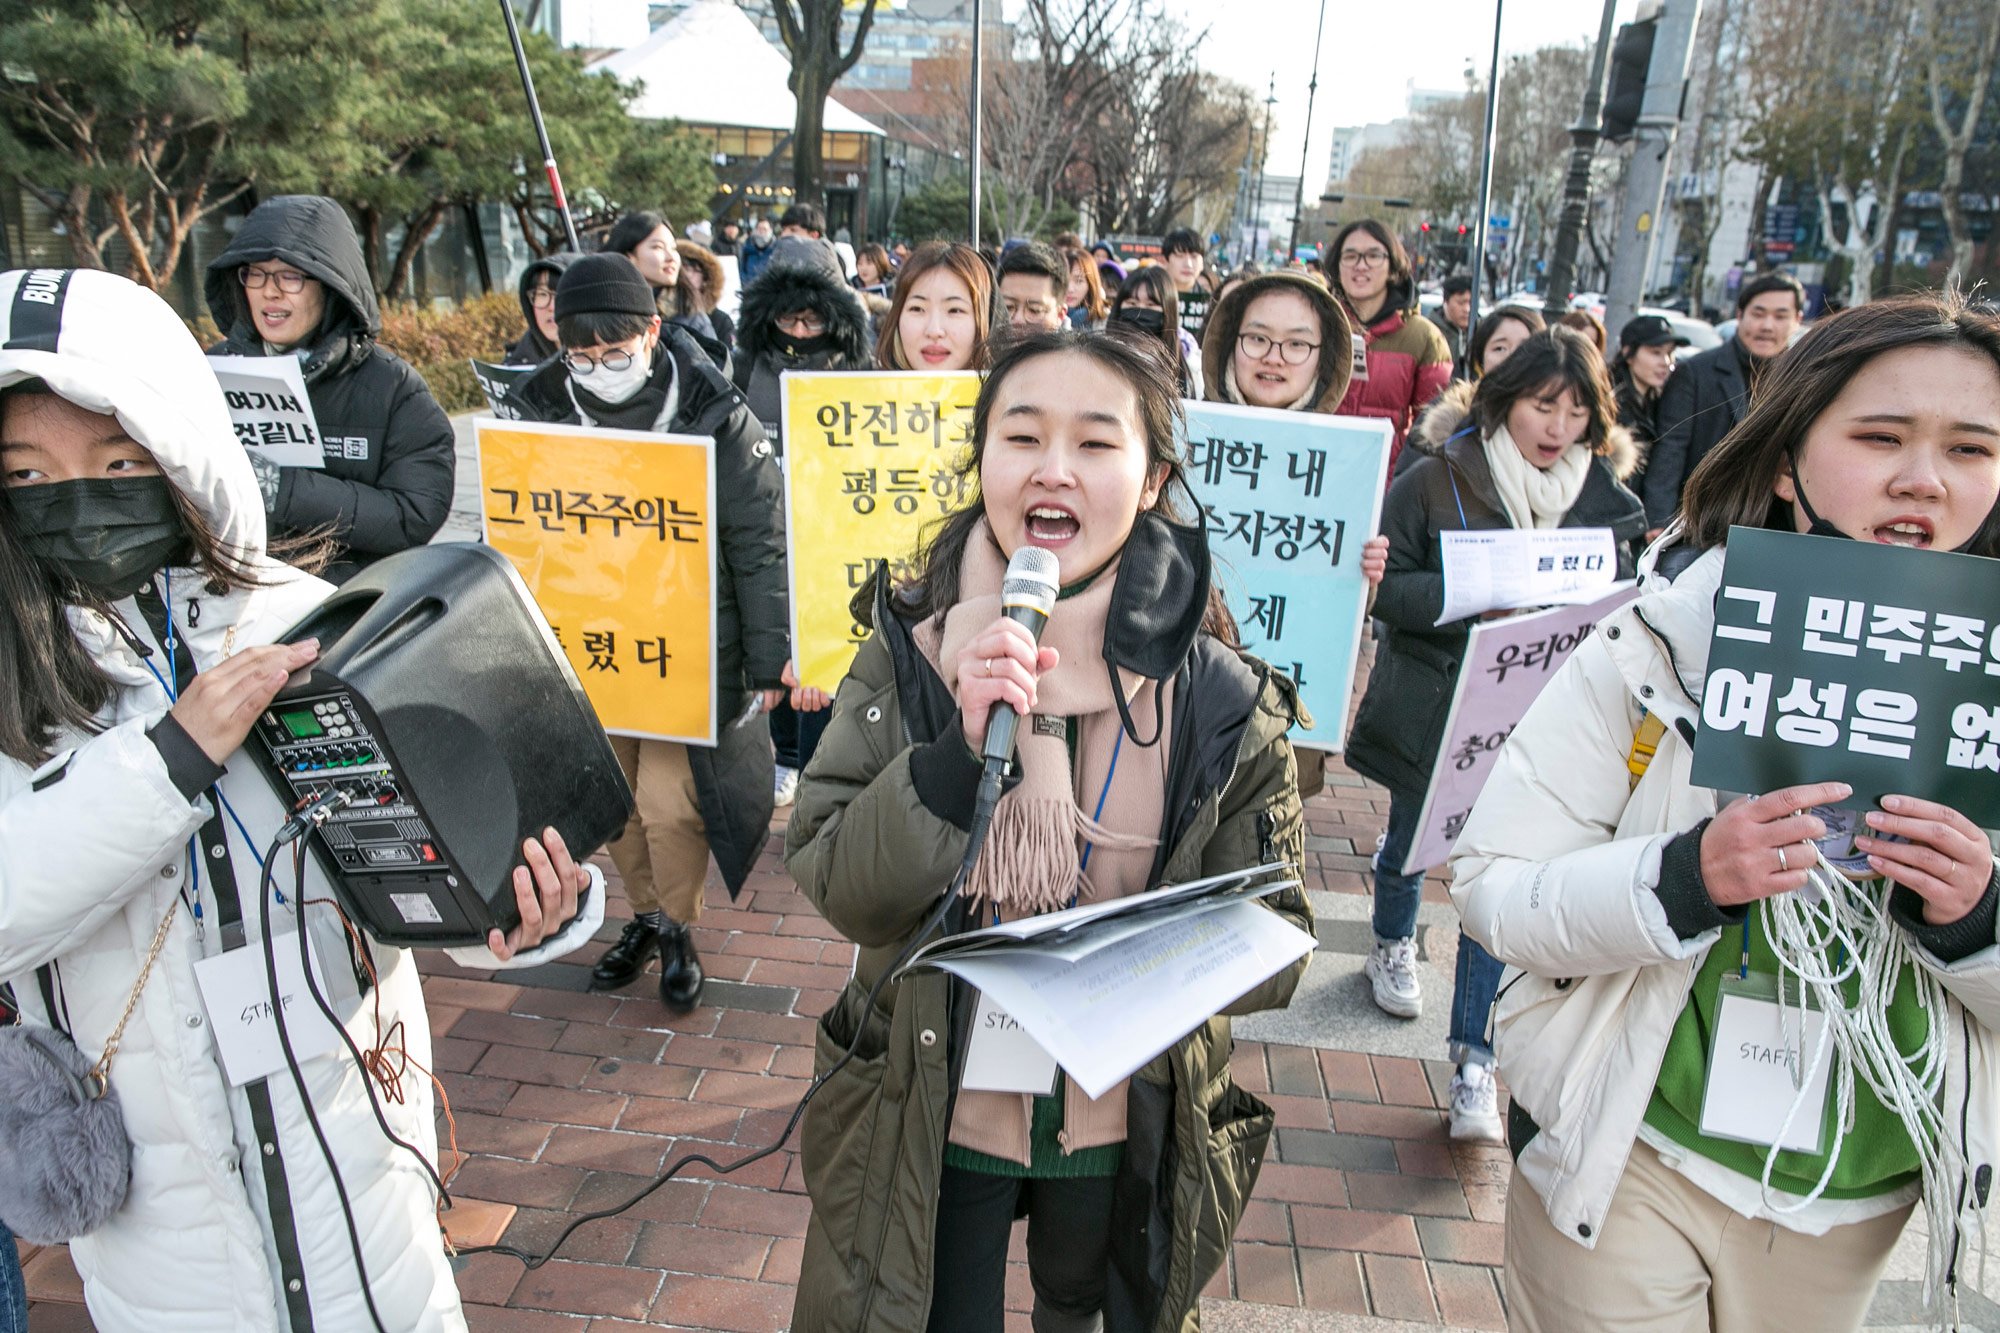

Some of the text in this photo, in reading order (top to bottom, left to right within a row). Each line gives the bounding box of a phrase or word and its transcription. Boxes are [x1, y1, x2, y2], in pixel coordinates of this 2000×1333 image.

[224, 390, 304, 414] 여기서
[816, 401, 976, 449] 안전하고
[1189, 437, 1327, 497] 대학 내
[489, 488, 525, 525] 그
[840, 467, 971, 515] 평등한
[1242, 594, 1287, 641] 제
[1715, 585, 1777, 644] 그
[1702, 667, 1918, 760] 여성은
[240, 994, 294, 1025] STAF
[984, 1011, 1025, 1032] STA
